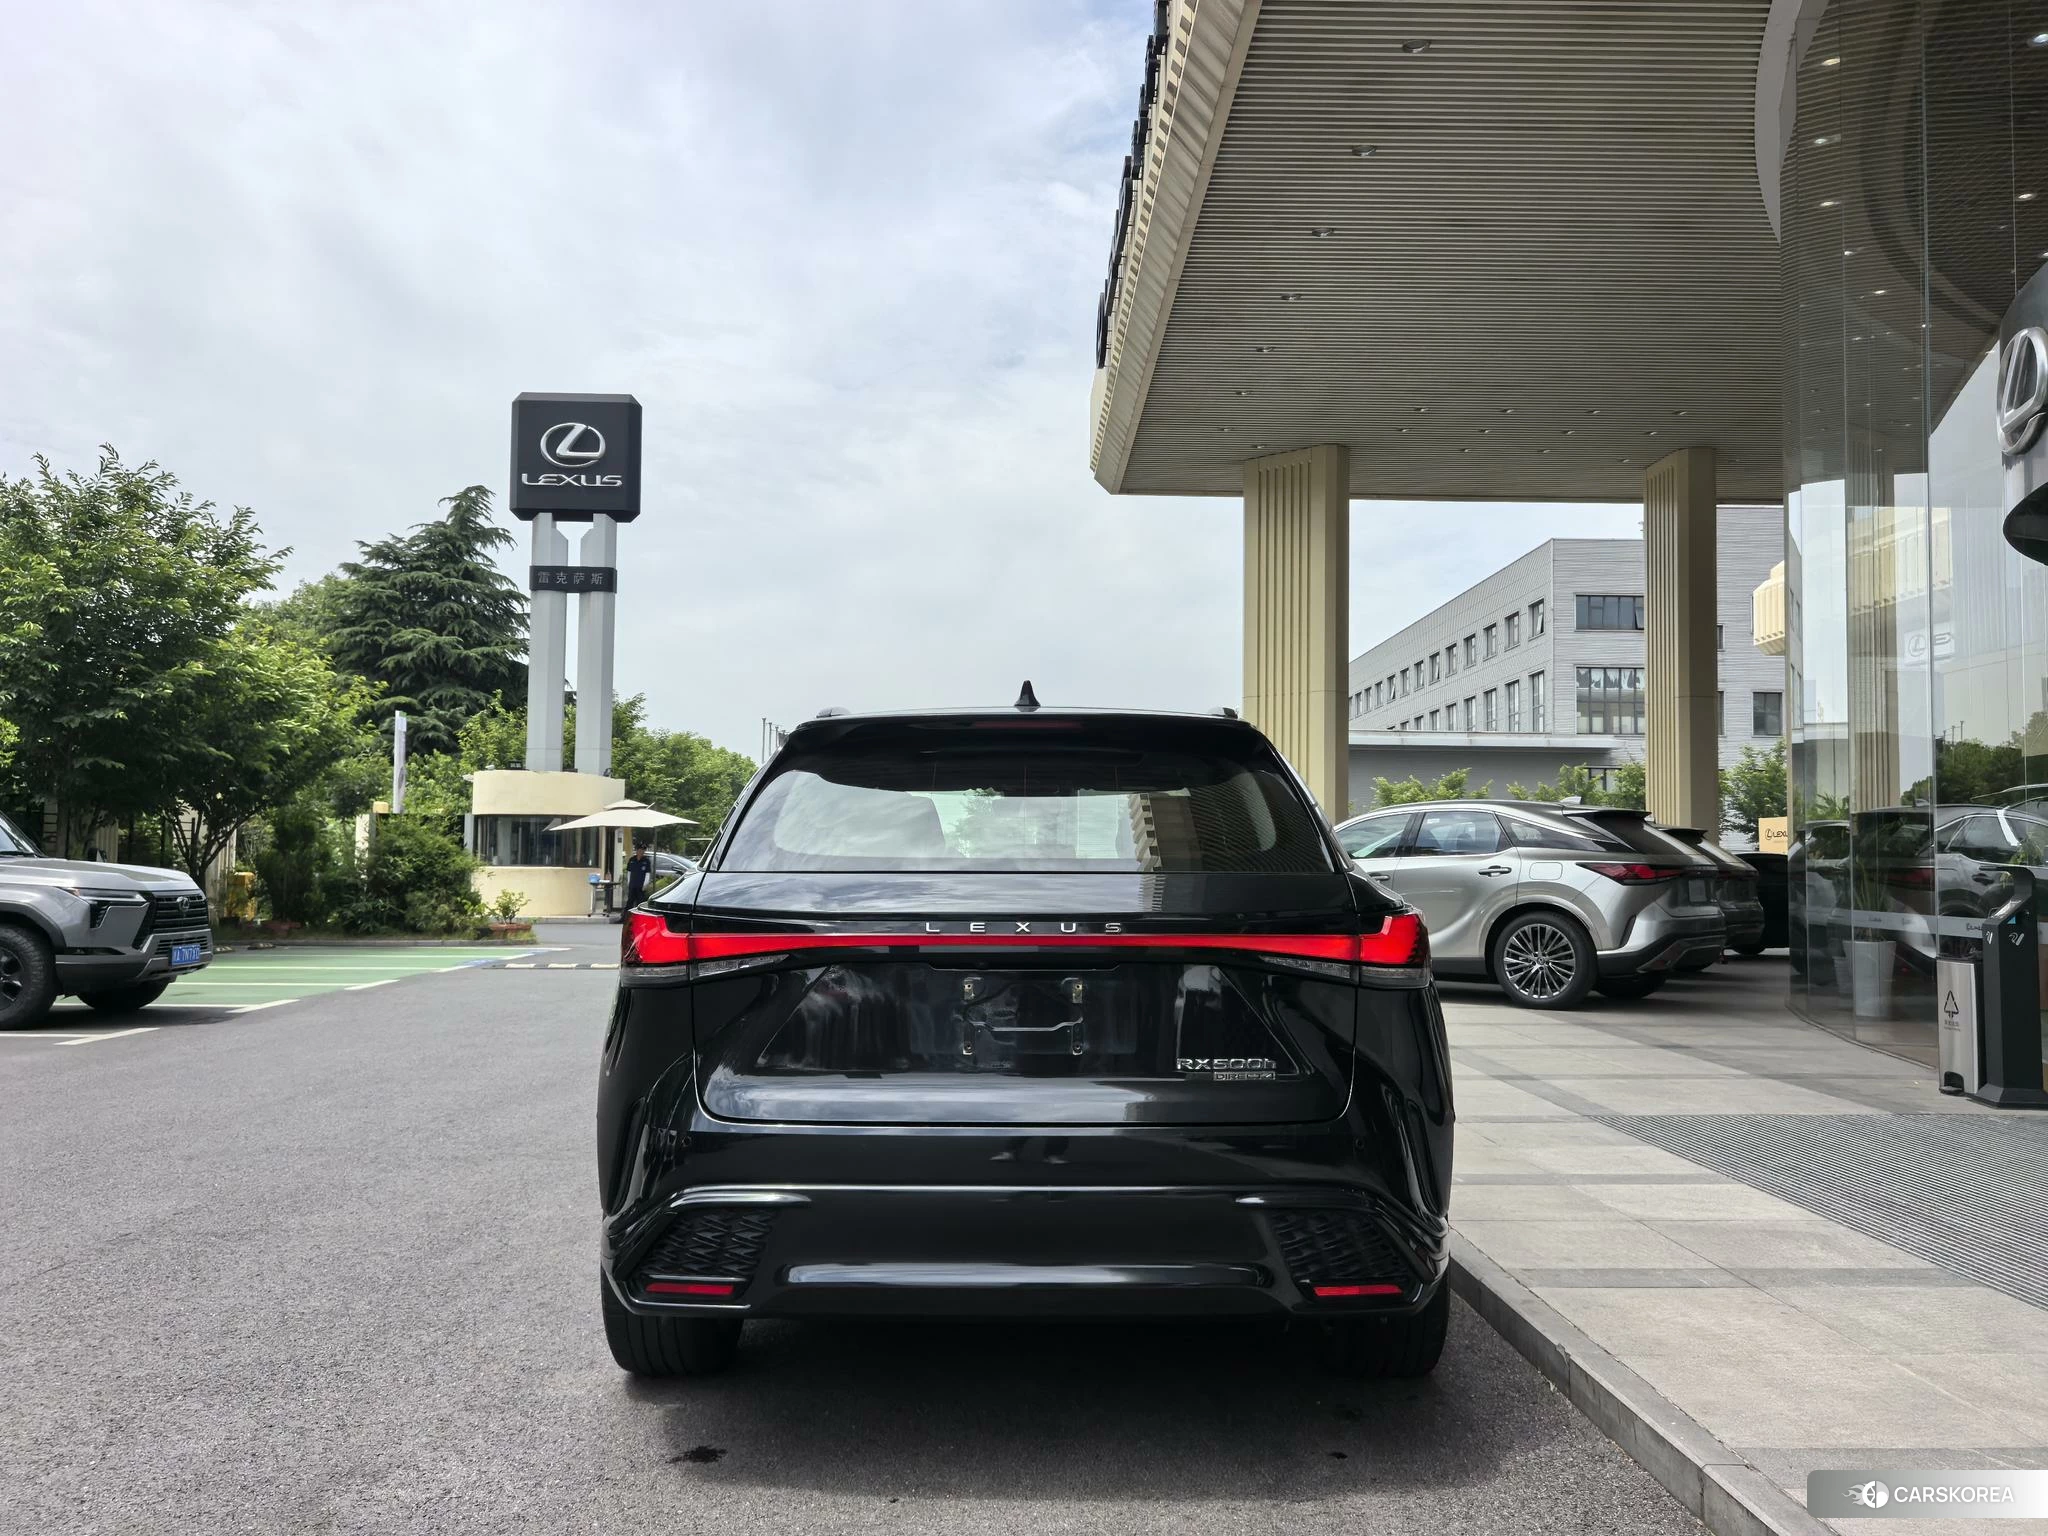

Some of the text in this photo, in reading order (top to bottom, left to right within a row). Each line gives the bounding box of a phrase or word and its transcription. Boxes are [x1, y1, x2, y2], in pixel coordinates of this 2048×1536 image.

[521, 473, 623, 487] LEXUS
[538, 571, 604, 585] 雷克萨斯
[925, 921, 1122, 933] LEXUS
